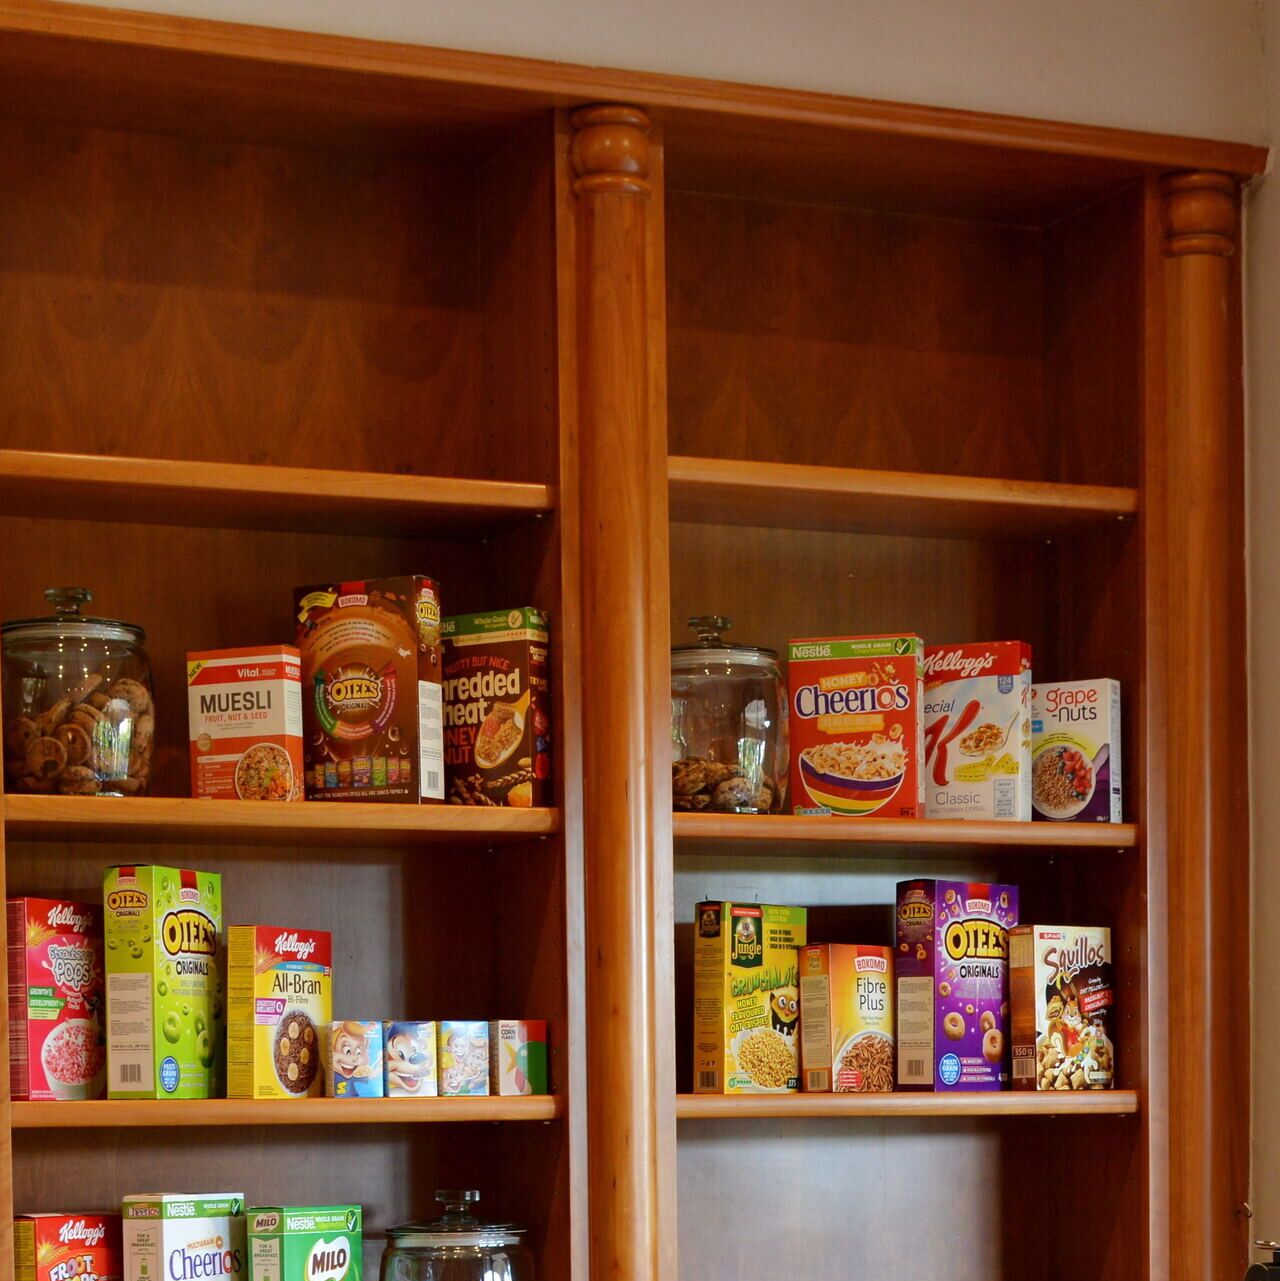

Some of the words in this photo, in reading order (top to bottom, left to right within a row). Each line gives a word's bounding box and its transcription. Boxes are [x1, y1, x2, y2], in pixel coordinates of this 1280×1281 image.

[474, 617, 492, 625] Whole
[472, 656, 487, 667] BUT
[489, 656, 510, 670] NICE
[923, 650, 997, 676] Kellogg's
[237, 668, 259, 677] Vital
[823, 674, 866, 688] HONEY
[332, 682, 379, 700] OTEES
[796, 681, 909, 717] Cheerios
[200, 690, 271, 714] MUESLI
[1046, 687, 1098, 712] grape
[205, 714, 225, 723] FRUIT,
[228, 713, 242, 721] NUT
[936, 791, 980, 805] Classic
[109, 891, 147, 909] OTEES
[968, 902, 990, 912] BOKOMO
[48, 904, 93, 932] Kellogg's
[901, 904, 931, 918] OTEES
[164, 912, 216, 955] OTEES
[946, 921, 1009, 960] OTEES
[274, 932, 316, 959] Kellogg's
[731, 934, 762, 959] Jungle
[857, 959, 885, 971] BOKOMO
[1044, 936, 1104, 983] Squillos
[176, 960, 209, 976] ORIGINALS
[960, 964, 999, 979] ORIGINALS
[272, 973, 322, 996] All-Bran
[857, 978, 886, 994] Fibre
[30, 999, 59, 1007] DEVELOPMENT
[738, 997, 757, 1008] HONEY
[860, 995, 884, 1011] Plus
[731, 1006, 764, 1021] FLAVOURED
[500, 1028, 517, 1036] CORN
[730, 1023, 743, 1032] OAT
[744, 1017, 768, 1030] CRISPIES
[1014, 1048, 1026, 1056] 350
[255, 1217, 277, 1227] MILO
[59, 1220, 106, 1246] Kellogg's
[187, 1239, 214, 1250] MULTIGRAIN
[170, 1249, 241, 1281] Cheerios
[311, 1247, 347, 1276] MILO
